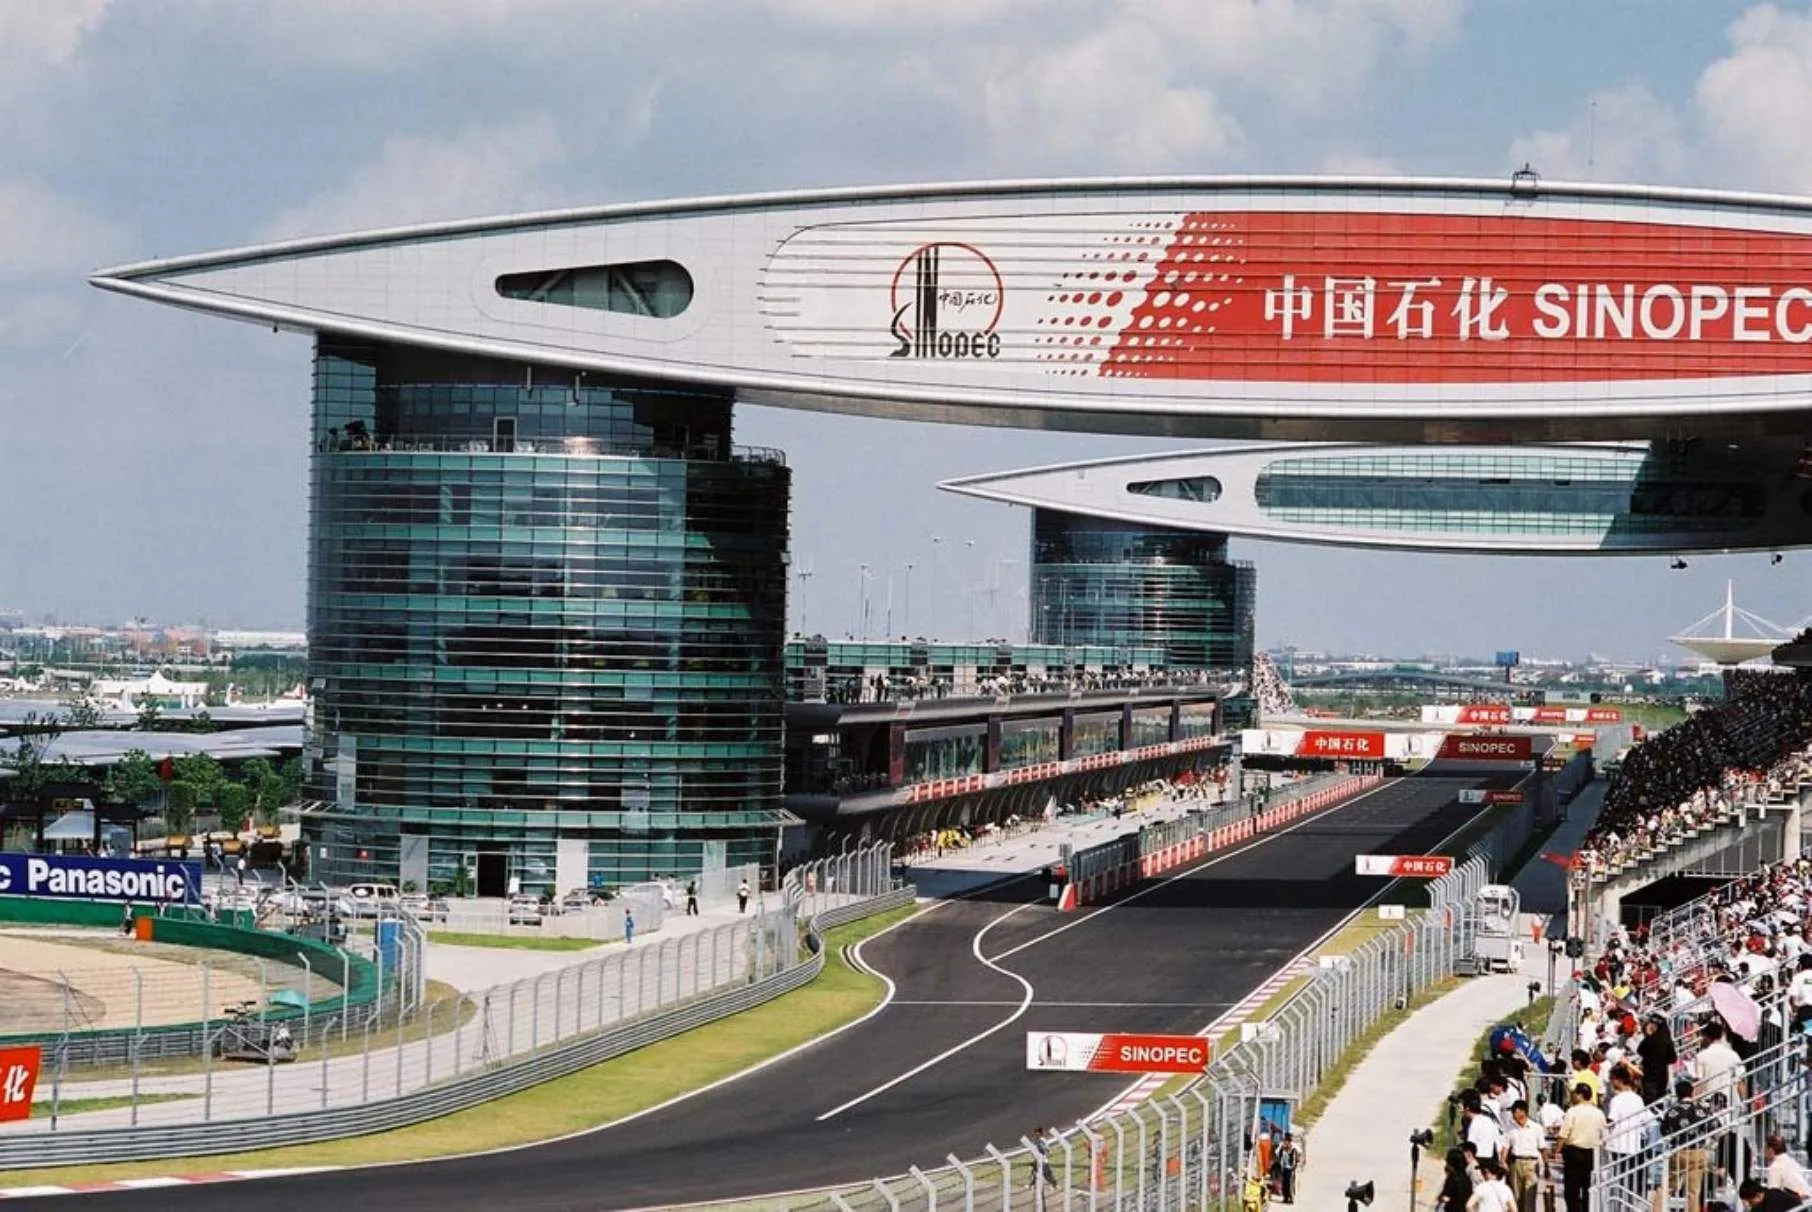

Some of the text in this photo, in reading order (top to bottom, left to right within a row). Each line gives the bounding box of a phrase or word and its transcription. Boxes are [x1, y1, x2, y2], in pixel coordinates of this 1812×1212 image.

[1264, 274, 1812, 343] 中国石化 SINOPEC
[1315, 737, 1370, 752] 中国石化
[1458, 741, 1516, 754] SINOPEC
[1403, 860, 1446, 873] 中国石化
[28, 858, 185, 898] Panasonic
[1120, 1046, 1201, 1063] SINOPEC
